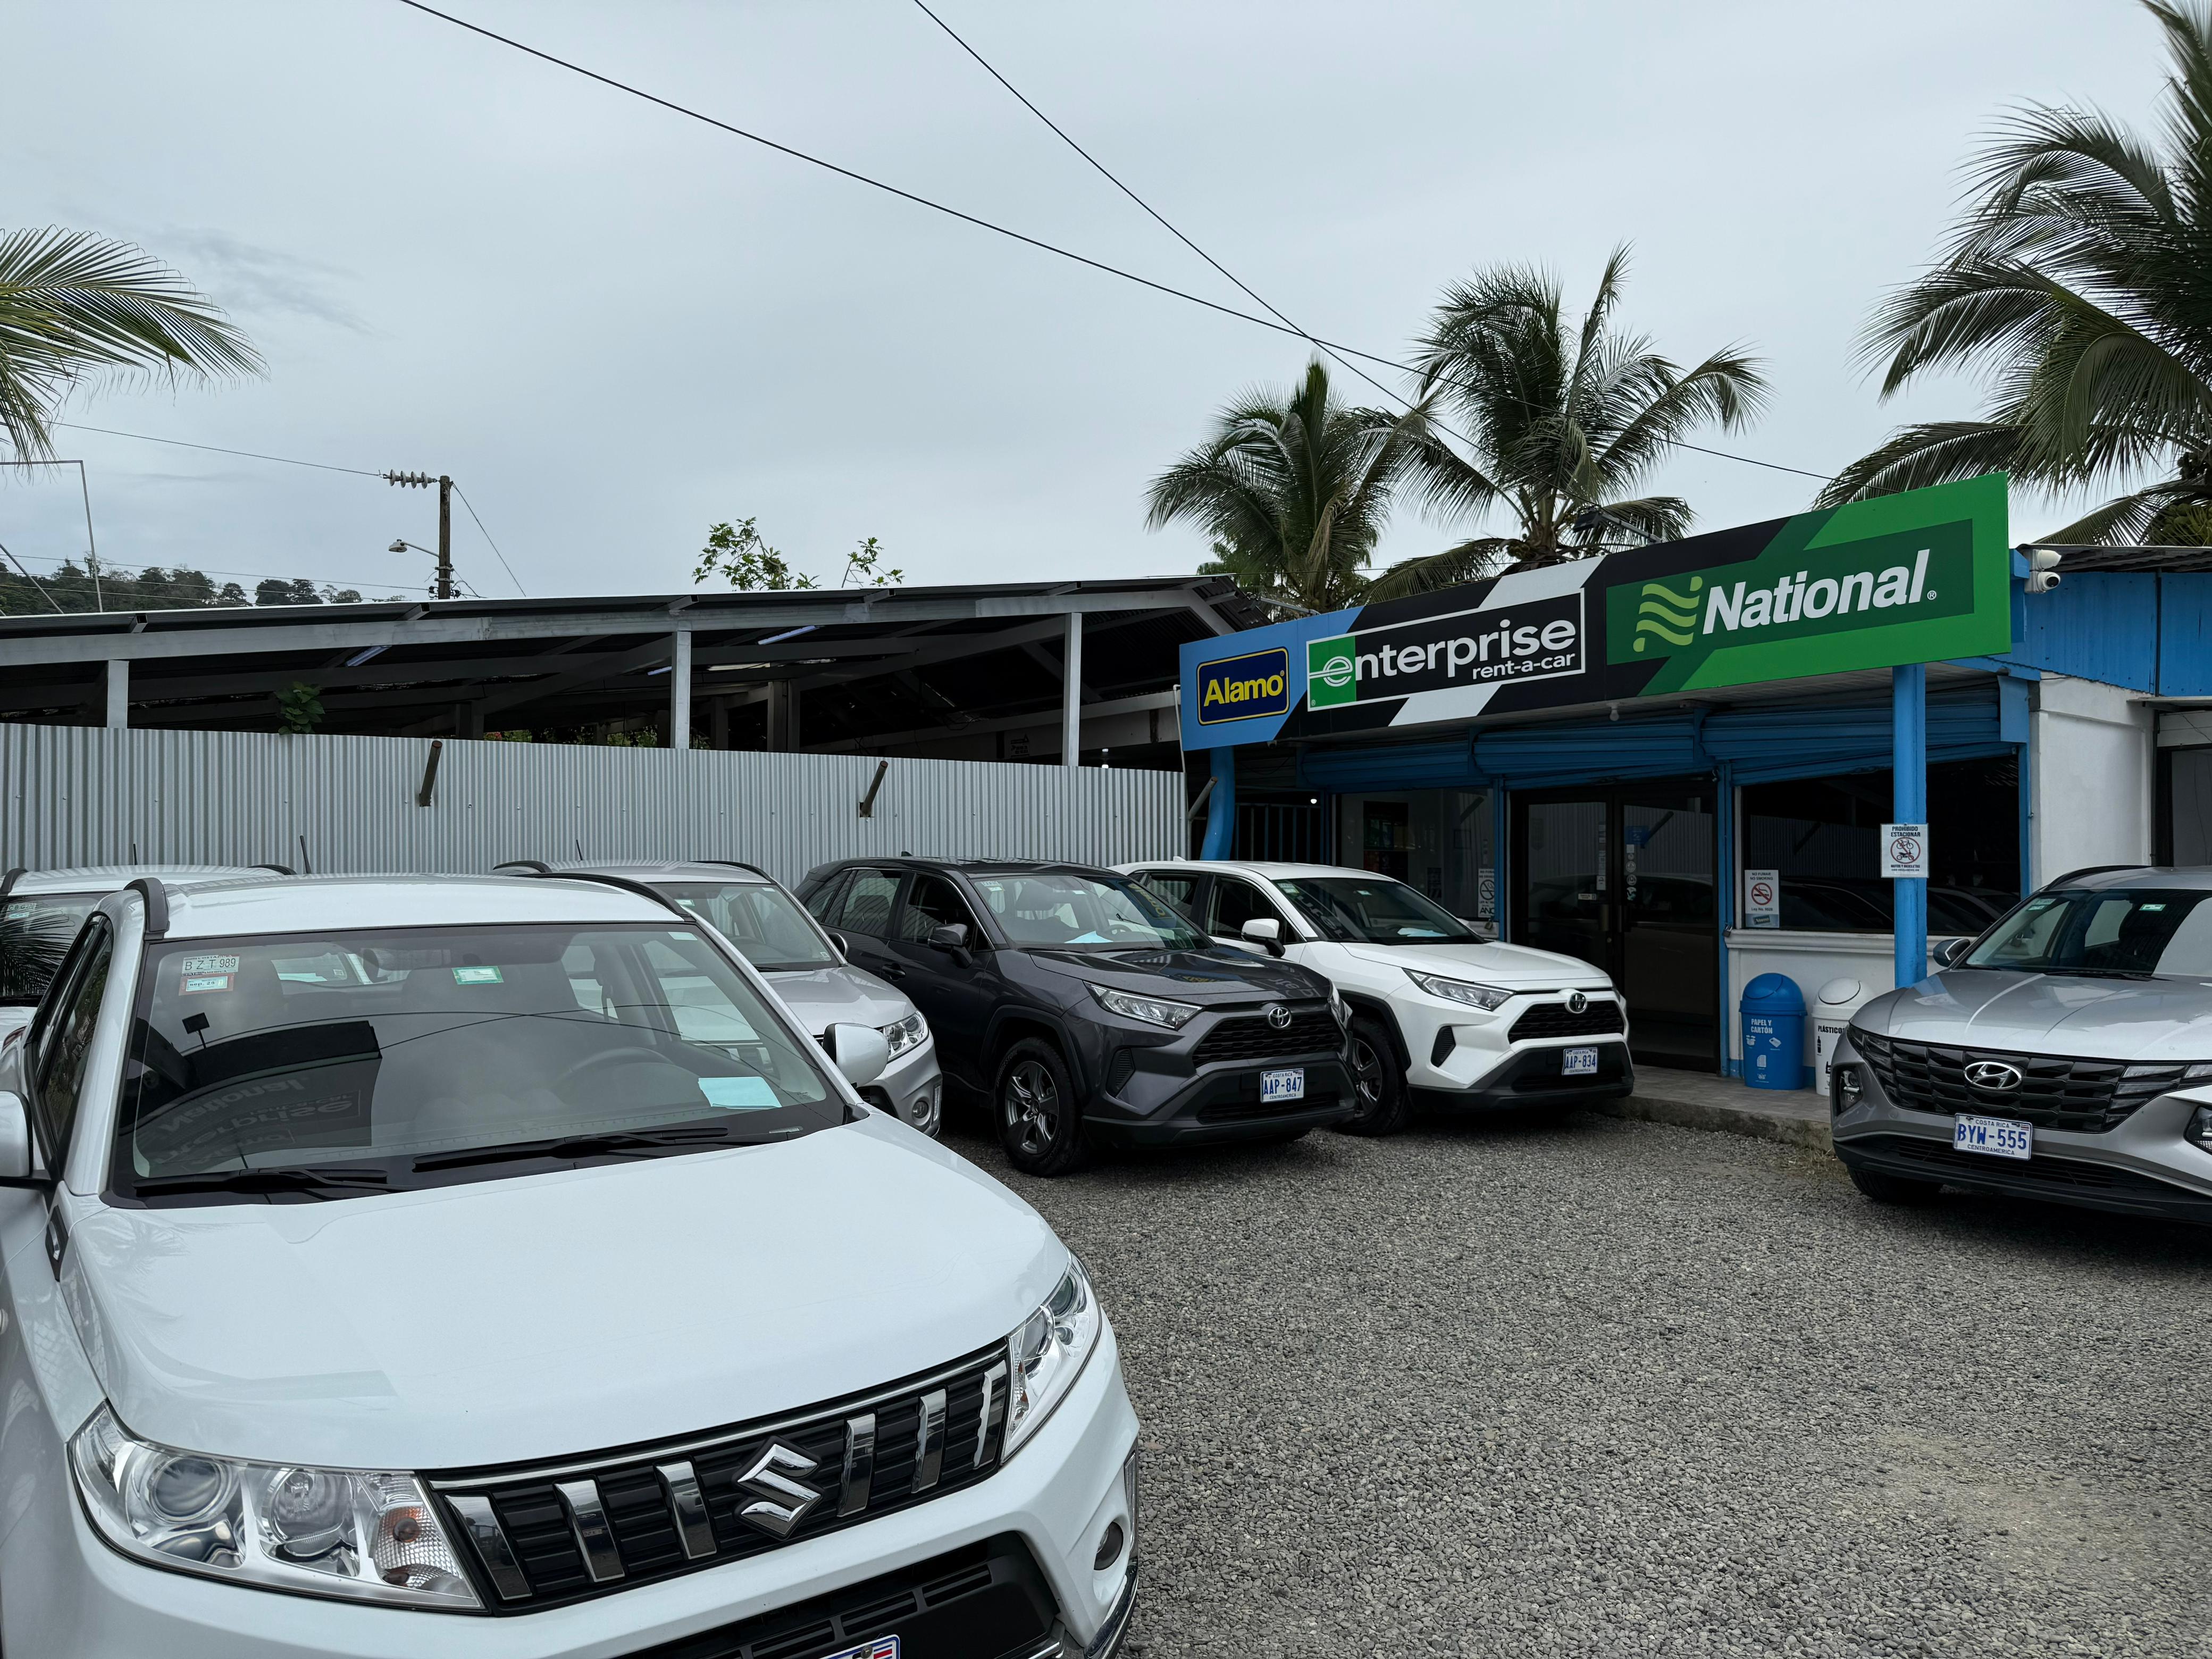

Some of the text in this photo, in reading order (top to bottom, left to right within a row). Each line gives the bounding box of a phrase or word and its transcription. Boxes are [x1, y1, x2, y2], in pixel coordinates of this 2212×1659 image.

[1703, 549, 1930, 635] National
[1311, 619, 1576, 686] enterprise
[1472, 652, 1576, 680] rent-a-car
[1203, 675, 1284, 707] Alamo
[1750, 1026, 1773, 1034] CARTÓN
[1817, 1025, 1844, 1034] PLÁSTICO
[1565, 1054, 1596, 1069] AAP-834
[1263, 1077, 1302, 1095] AAP-847
[1957, 1124, 2026, 1150] BYW-555
[1967, 1144, 2015, 1155] CENTROAMERICA
